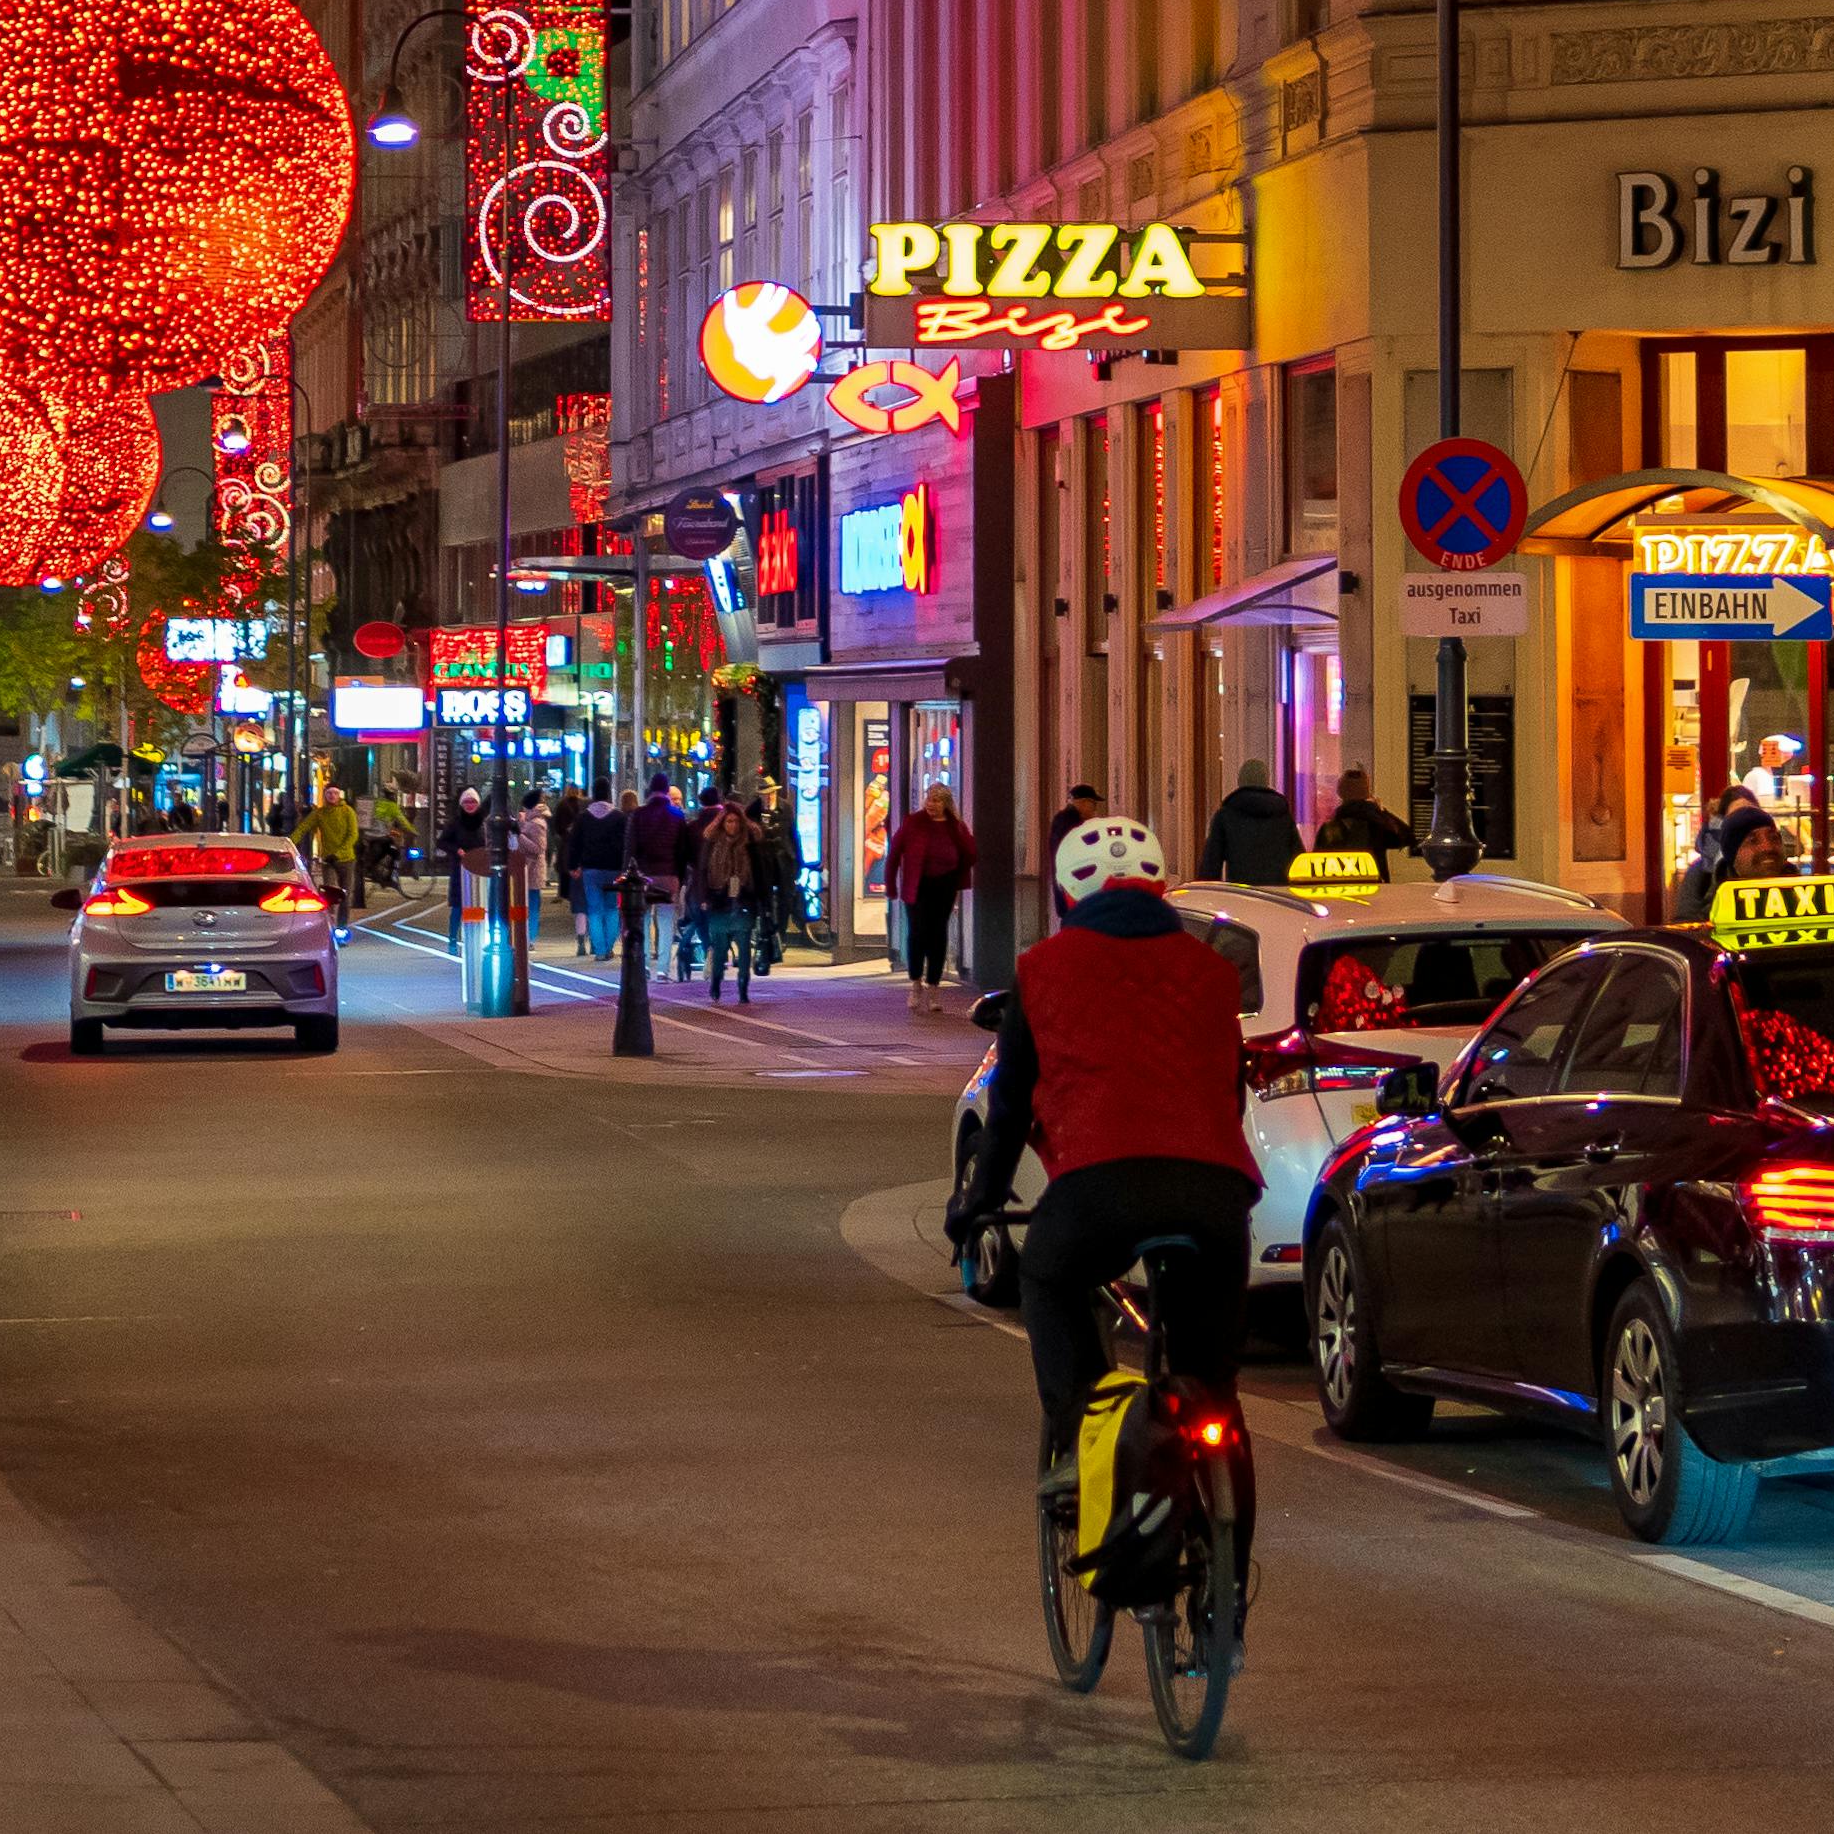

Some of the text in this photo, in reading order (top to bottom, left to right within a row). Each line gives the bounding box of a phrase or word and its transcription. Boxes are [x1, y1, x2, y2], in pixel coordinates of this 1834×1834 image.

[1616, 165, 1816, 270] Bizi
[869, 222, 1206, 298] PIZZA
[917, 300, 1150, 351] Bizi
[1440, 551, 1488, 570] ENDE
[1407, 582, 1522, 601] ausgenommen
[1448, 606, 1482, 624] Taxi
[1654, 592, 1768, 620] EINBAHN
[1310, 856, 1369, 877] TAXI
